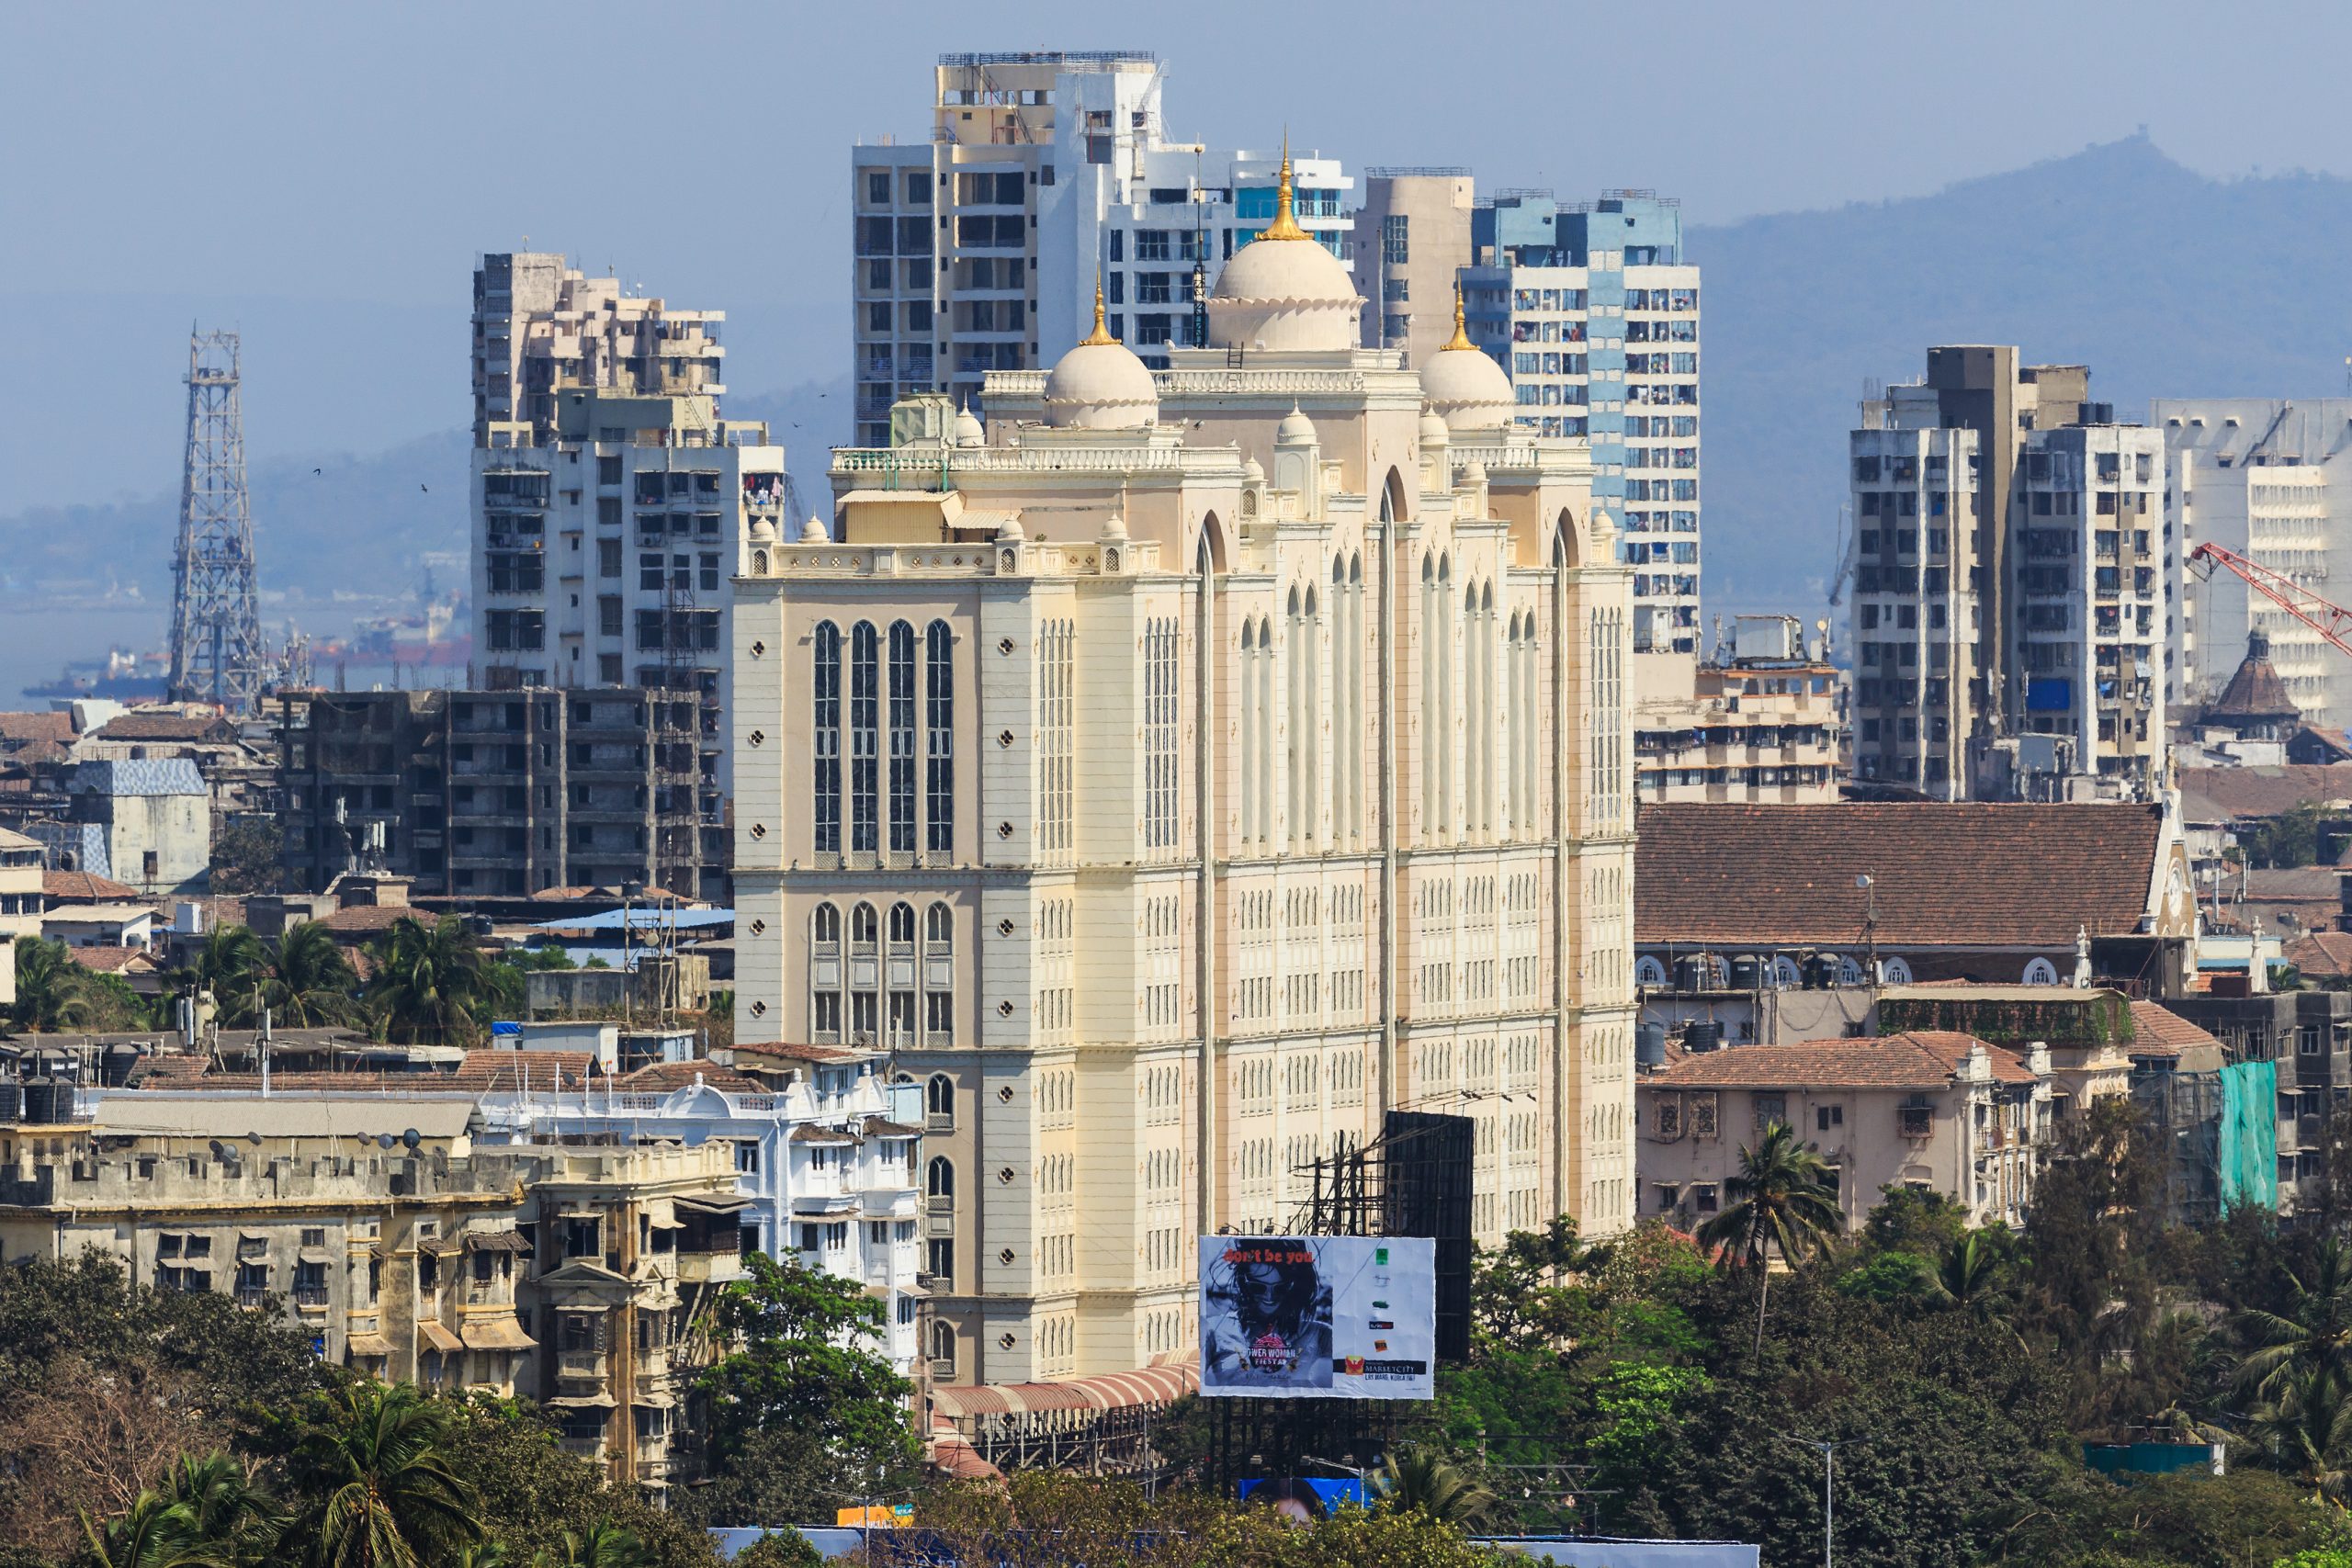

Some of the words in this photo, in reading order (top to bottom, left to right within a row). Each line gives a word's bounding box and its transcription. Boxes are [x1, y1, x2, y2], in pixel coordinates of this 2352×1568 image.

[1223, 1248, 1261, 1263] don't
[1265, 1249, 1283, 1262] be
[1243, 1348, 1267, 1358] OWER
[1268, 1348, 1295, 1359] WOMAN
